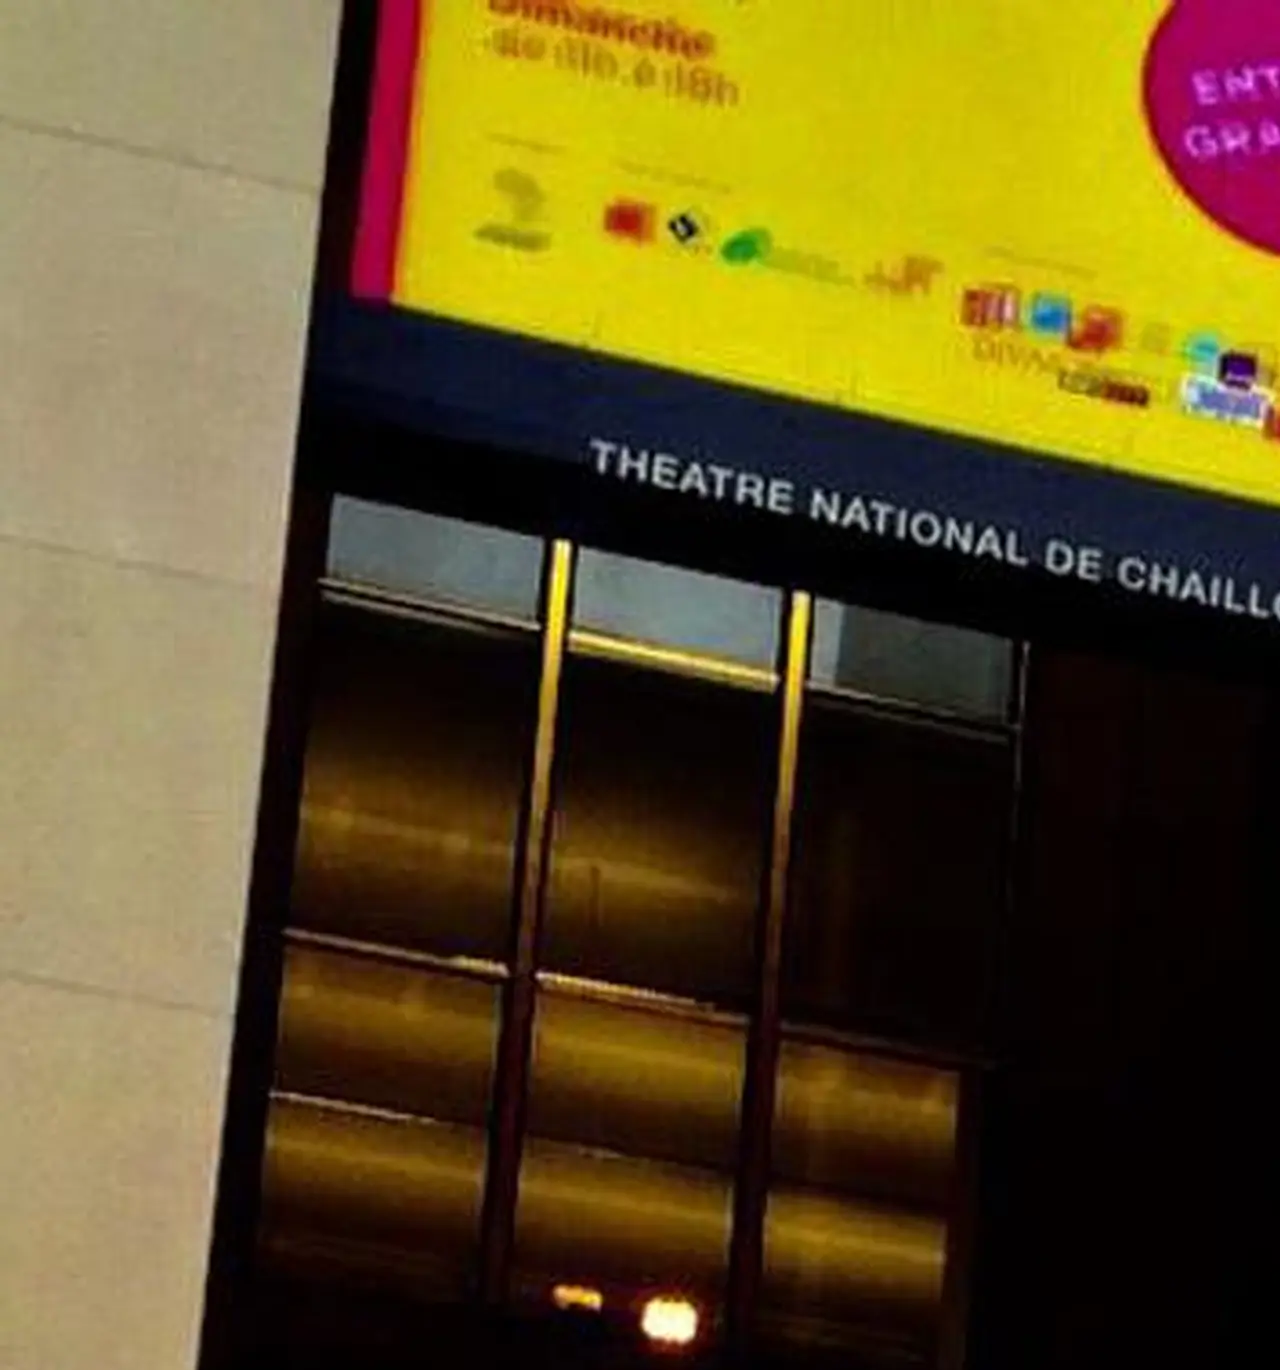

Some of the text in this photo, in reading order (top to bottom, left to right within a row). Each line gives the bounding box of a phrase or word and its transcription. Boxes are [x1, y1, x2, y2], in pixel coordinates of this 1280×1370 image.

[589, 437, 795, 515] THEATRE
[809, 487, 1028, 567] NATIONAL
[1044, 539, 1102, 583] DE
